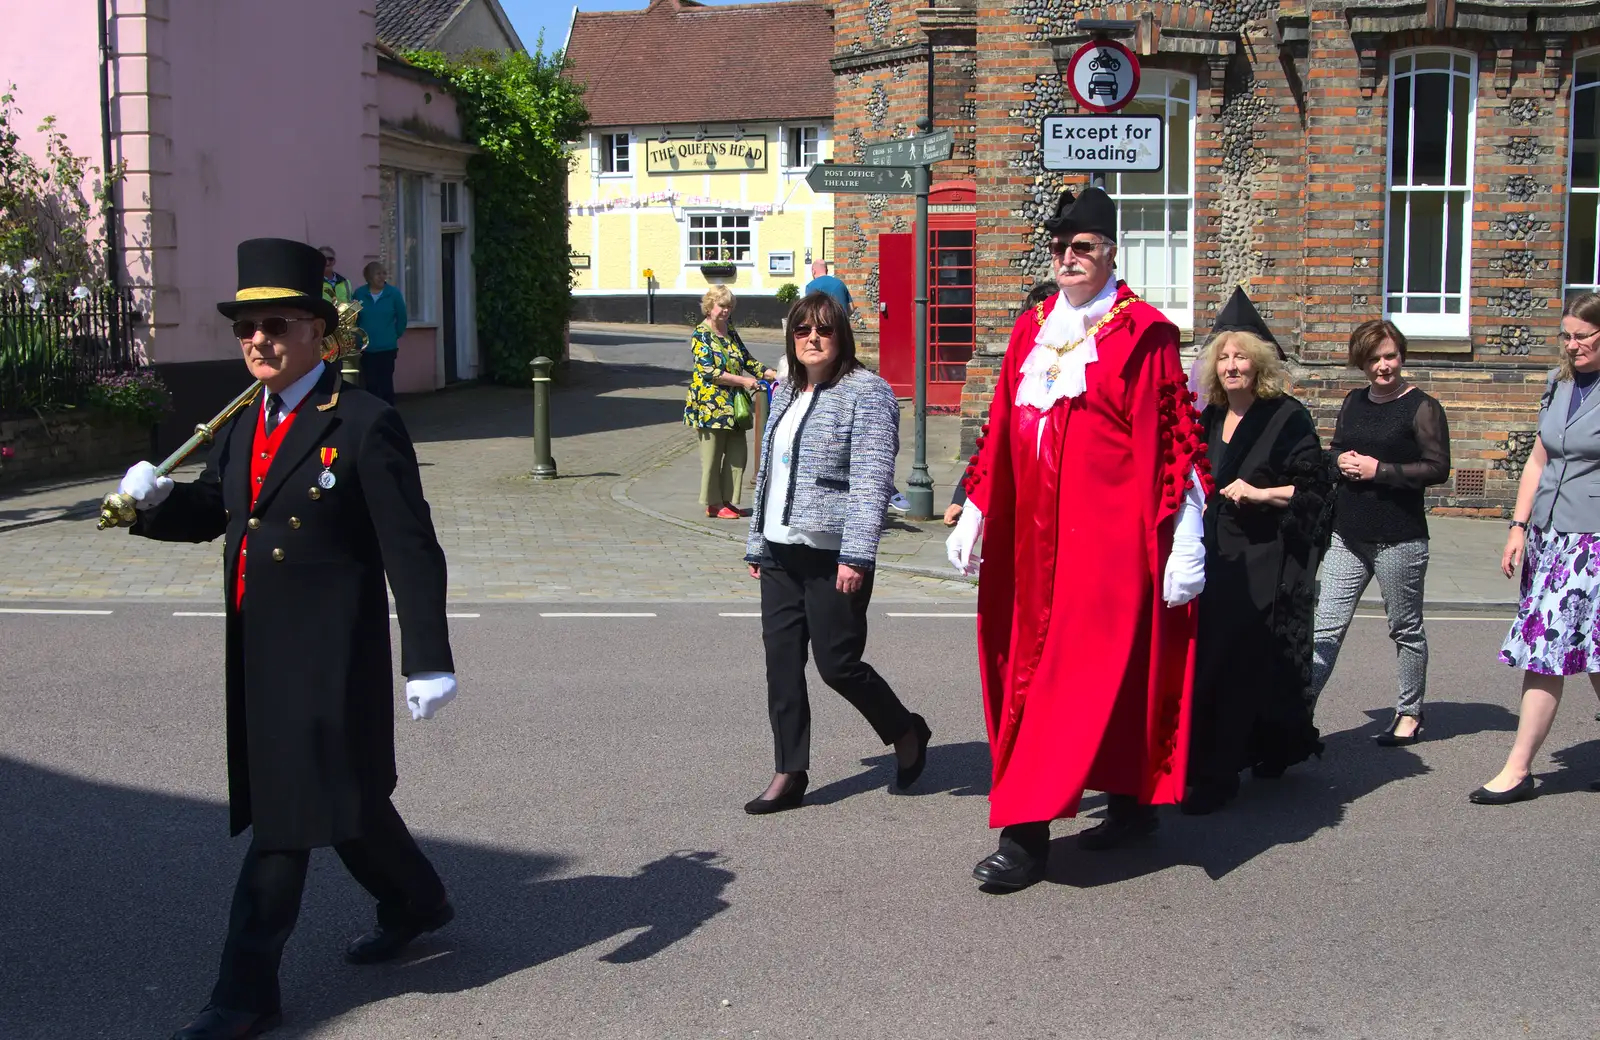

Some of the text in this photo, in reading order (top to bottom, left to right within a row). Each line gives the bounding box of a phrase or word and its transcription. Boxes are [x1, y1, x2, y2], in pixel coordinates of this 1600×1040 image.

[1052, 123, 1152, 142] Except for
[650, 142, 763, 163] THE QUEENS HEAD
[1068, 144, 1137, 163] loading
[848, 170, 875, 178] OFFICE
